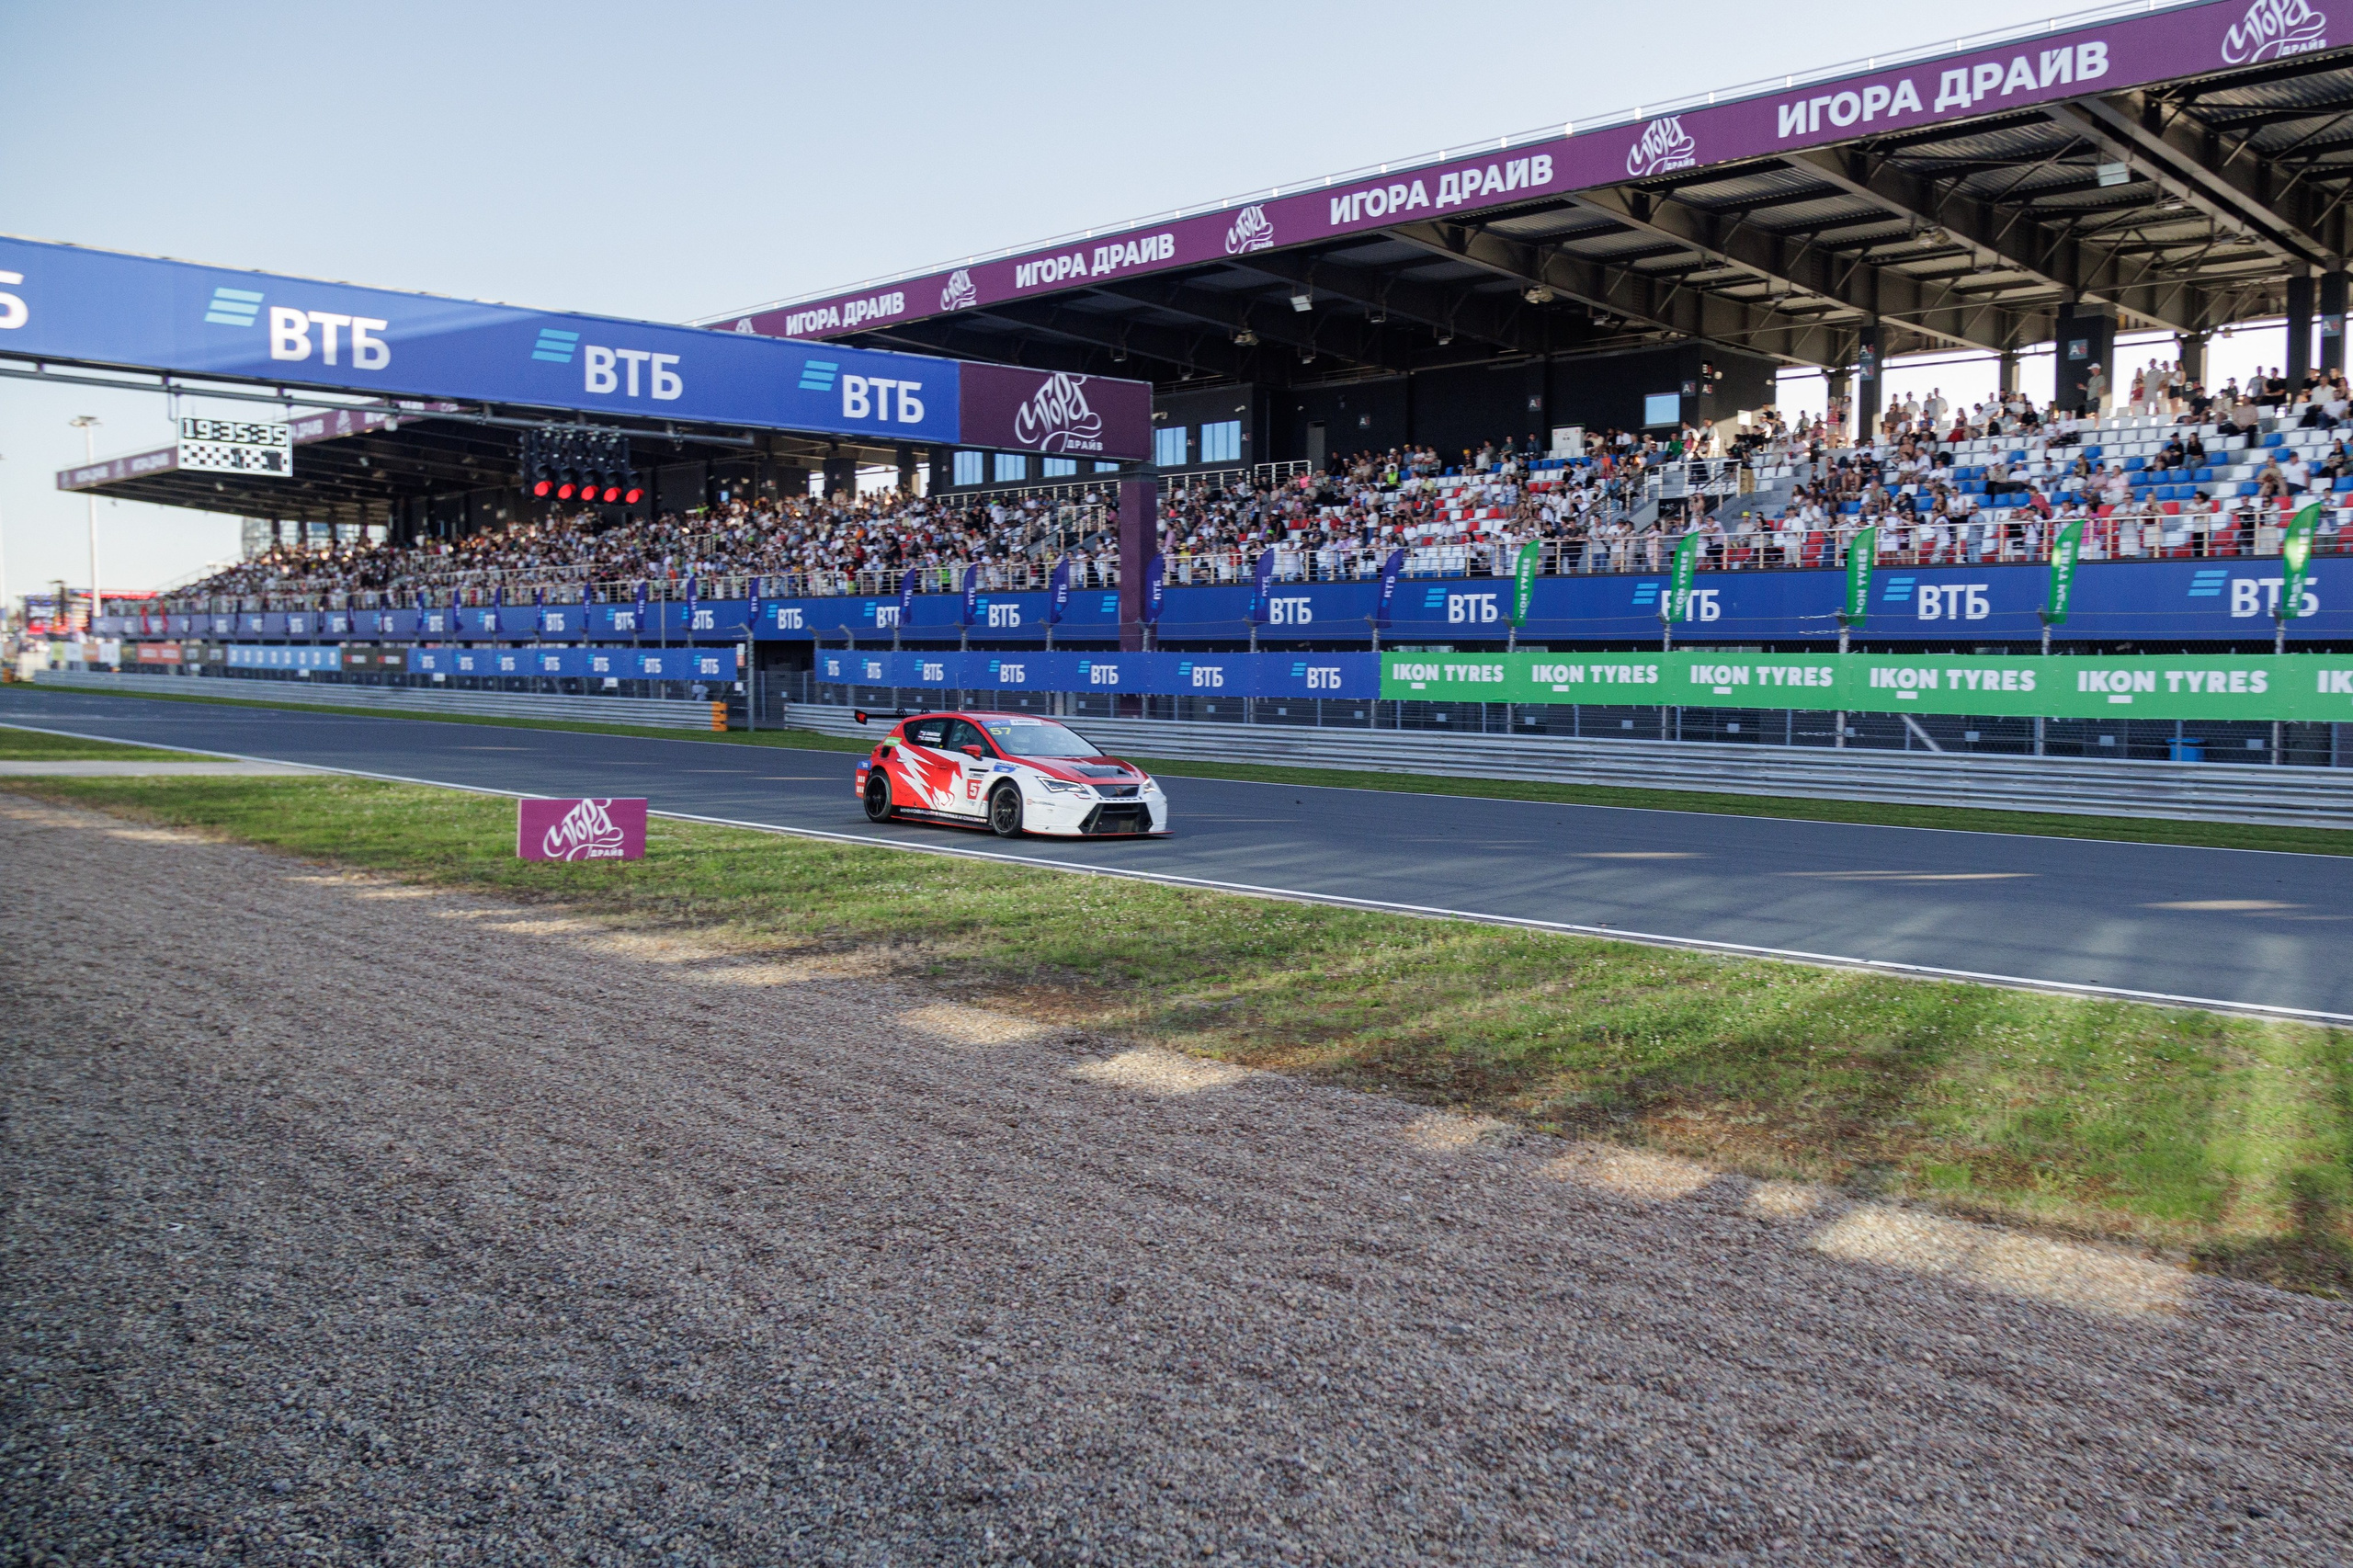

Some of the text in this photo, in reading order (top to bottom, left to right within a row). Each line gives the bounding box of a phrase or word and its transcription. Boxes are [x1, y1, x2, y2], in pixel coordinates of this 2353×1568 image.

[2281, 39, 2326, 55] ДРАЙВ
[1778, 40, 2109, 138] ИГОРА ДРАЙВ
[1330, 153, 1553, 225] ИГОРА ДРАЙВ
[1016, 233, 1176, 290] ИГОРА ДРАЙВ
[786, 306, 840, 336] ИГОРА
[842, 291, 904, 327] ДРАЙВ
[269, 306, 389, 369] ВТБ
[585, 346, 682, 400] ВТБ
[843, 375, 924, 423] ВТБ
[185, 419, 287, 446] 19:35:35
[1066, 439, 1103, 450] ДРАЙВ
[1857, 549, 1868, 586] TYRES
[1057, 585, 1067, 603] ВТБ
[1918, 585, 1989, 619] ВТБ
[779, 608, 802, 629] ВТБ
[989, 605, 1020, 627] ВТБ
[1269, 597, 1313, 624] ВТБ
[1449, 594, 1497, 623] ВТБ
[924, 664, 943, 680] ВТБ
[1001, 665, 1025, 682] ВТБ
[1091, 665, 1119, 684] ВТБ
[1193, 667, 1223, 687] ВТБ
[1308, 667, 1341, 688] ВТБ
[1392, 664, 1504, 682] IKON TYRES
[1532, 665, 1657, 683] IKON TYRES
[1690, 665, 1833, 687] IKON TYRES
[1870, 668, 2035, 691] IKON TYRES
[2078, 670, 2268, 693] IKON TYRES
[2318, 670, 2353, 693] IK
